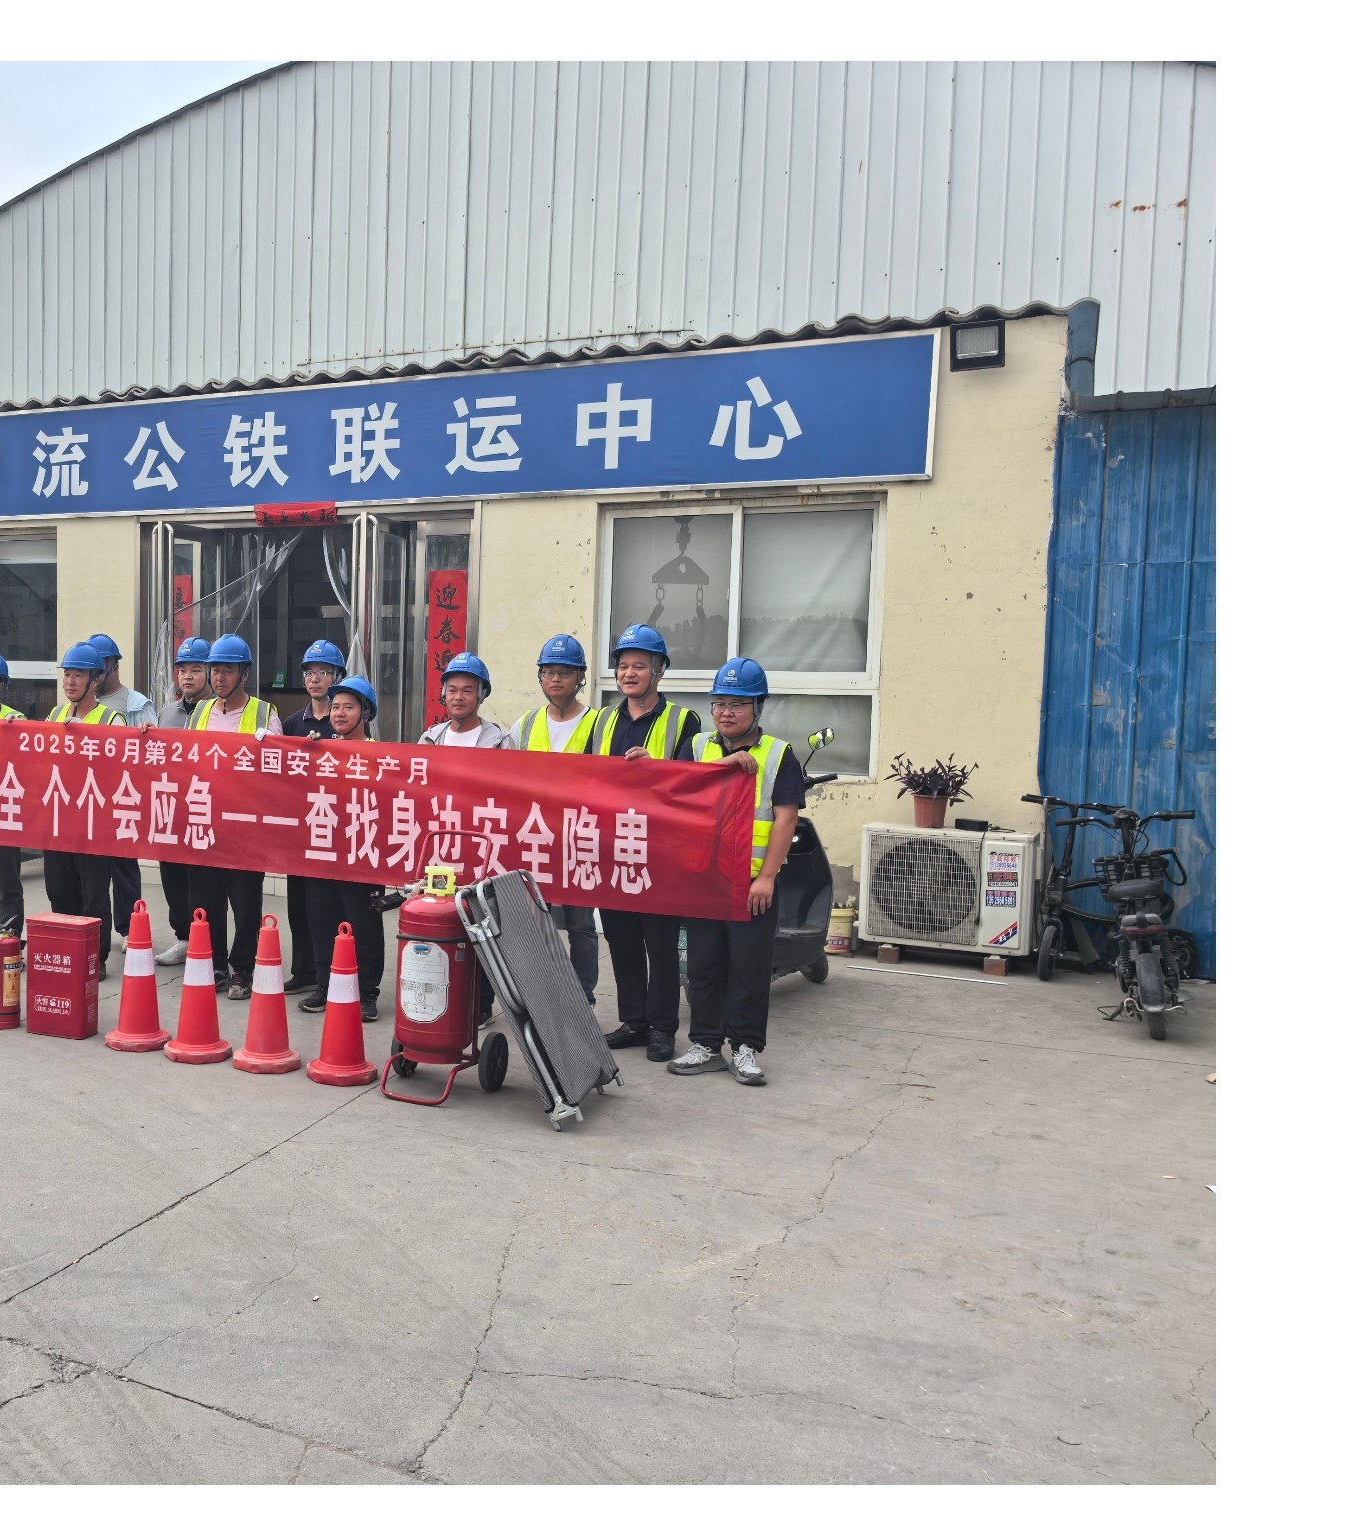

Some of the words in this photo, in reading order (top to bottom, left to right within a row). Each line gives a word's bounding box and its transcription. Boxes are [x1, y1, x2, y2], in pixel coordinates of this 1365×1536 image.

[19, 732, 431, 786] 2025年6月第24个全国安全生产月
[33, 953, 71, 966] 灭火器箱
[36, 997, 48, 1006] 火警
[57, 1000, 70, 1009] 119
